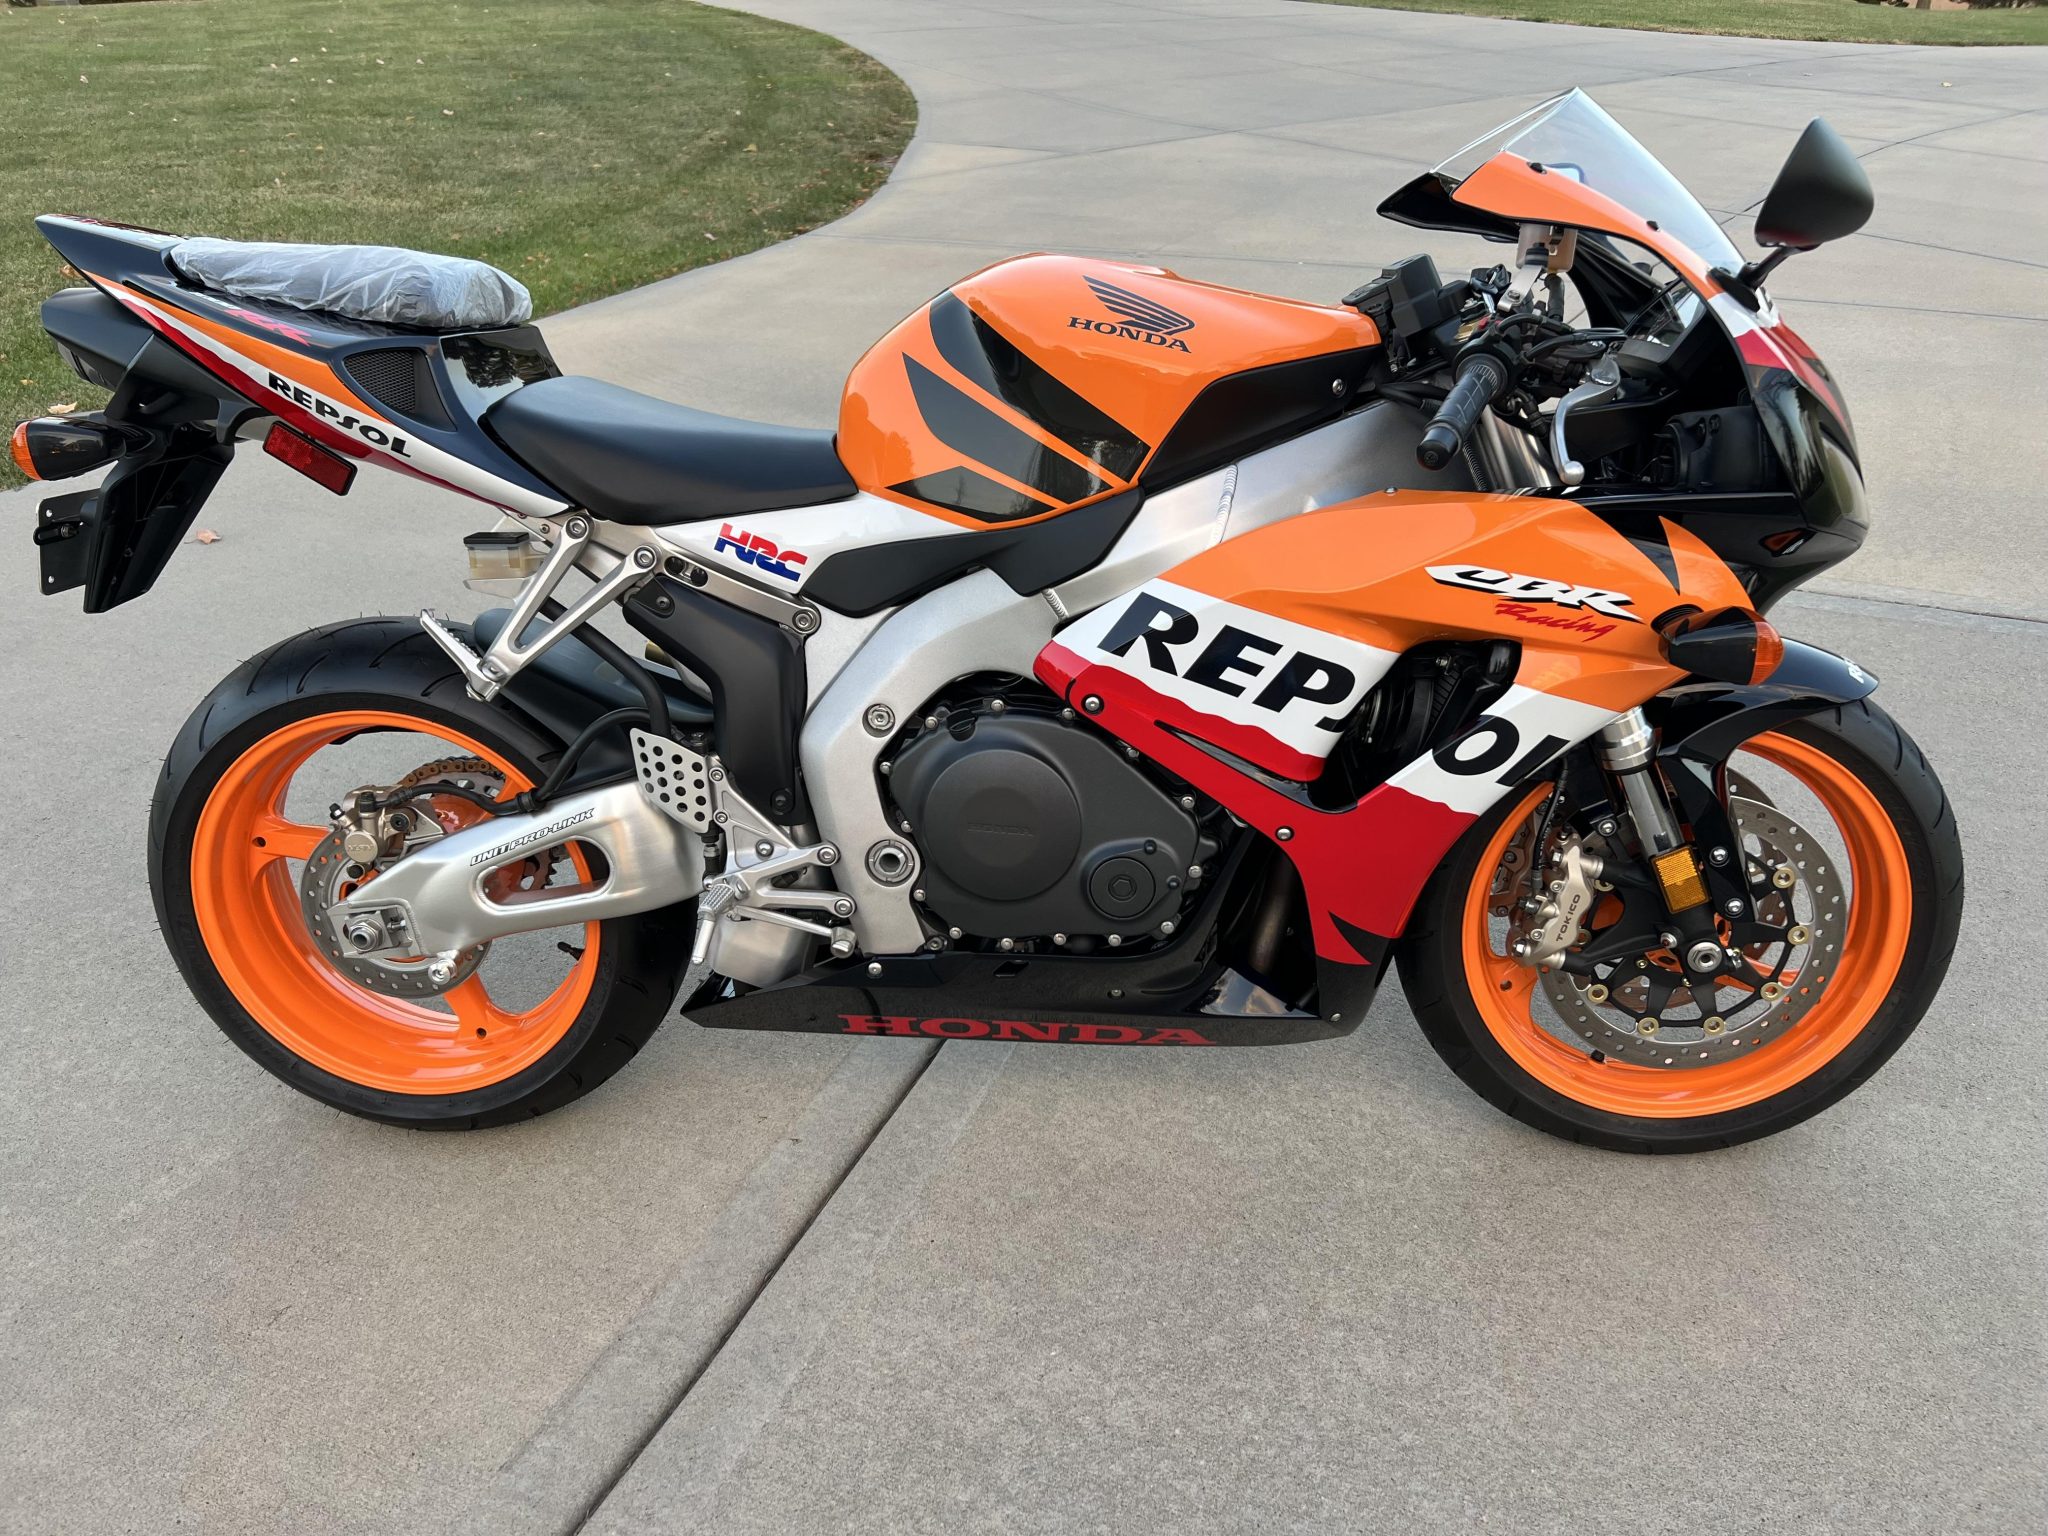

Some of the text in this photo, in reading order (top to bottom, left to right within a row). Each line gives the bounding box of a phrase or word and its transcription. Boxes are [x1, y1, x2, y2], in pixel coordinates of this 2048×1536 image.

[1066, 316, 1192, 354] HONDA
[268, 371, 411, 458] REPSOL
[713, 522, 808, 582] HRC
[1424, 564, 1647, 625] CBR
[1495, 603, 1617, 643] Racing
[1097, 591, 1571, 788] REPOL
[470, 807, 595, 866] UNIT PRO-LINK
[1556, 894, 1580, 942] TOKICO
[837, 1014, 1216, 1046] HONDA
